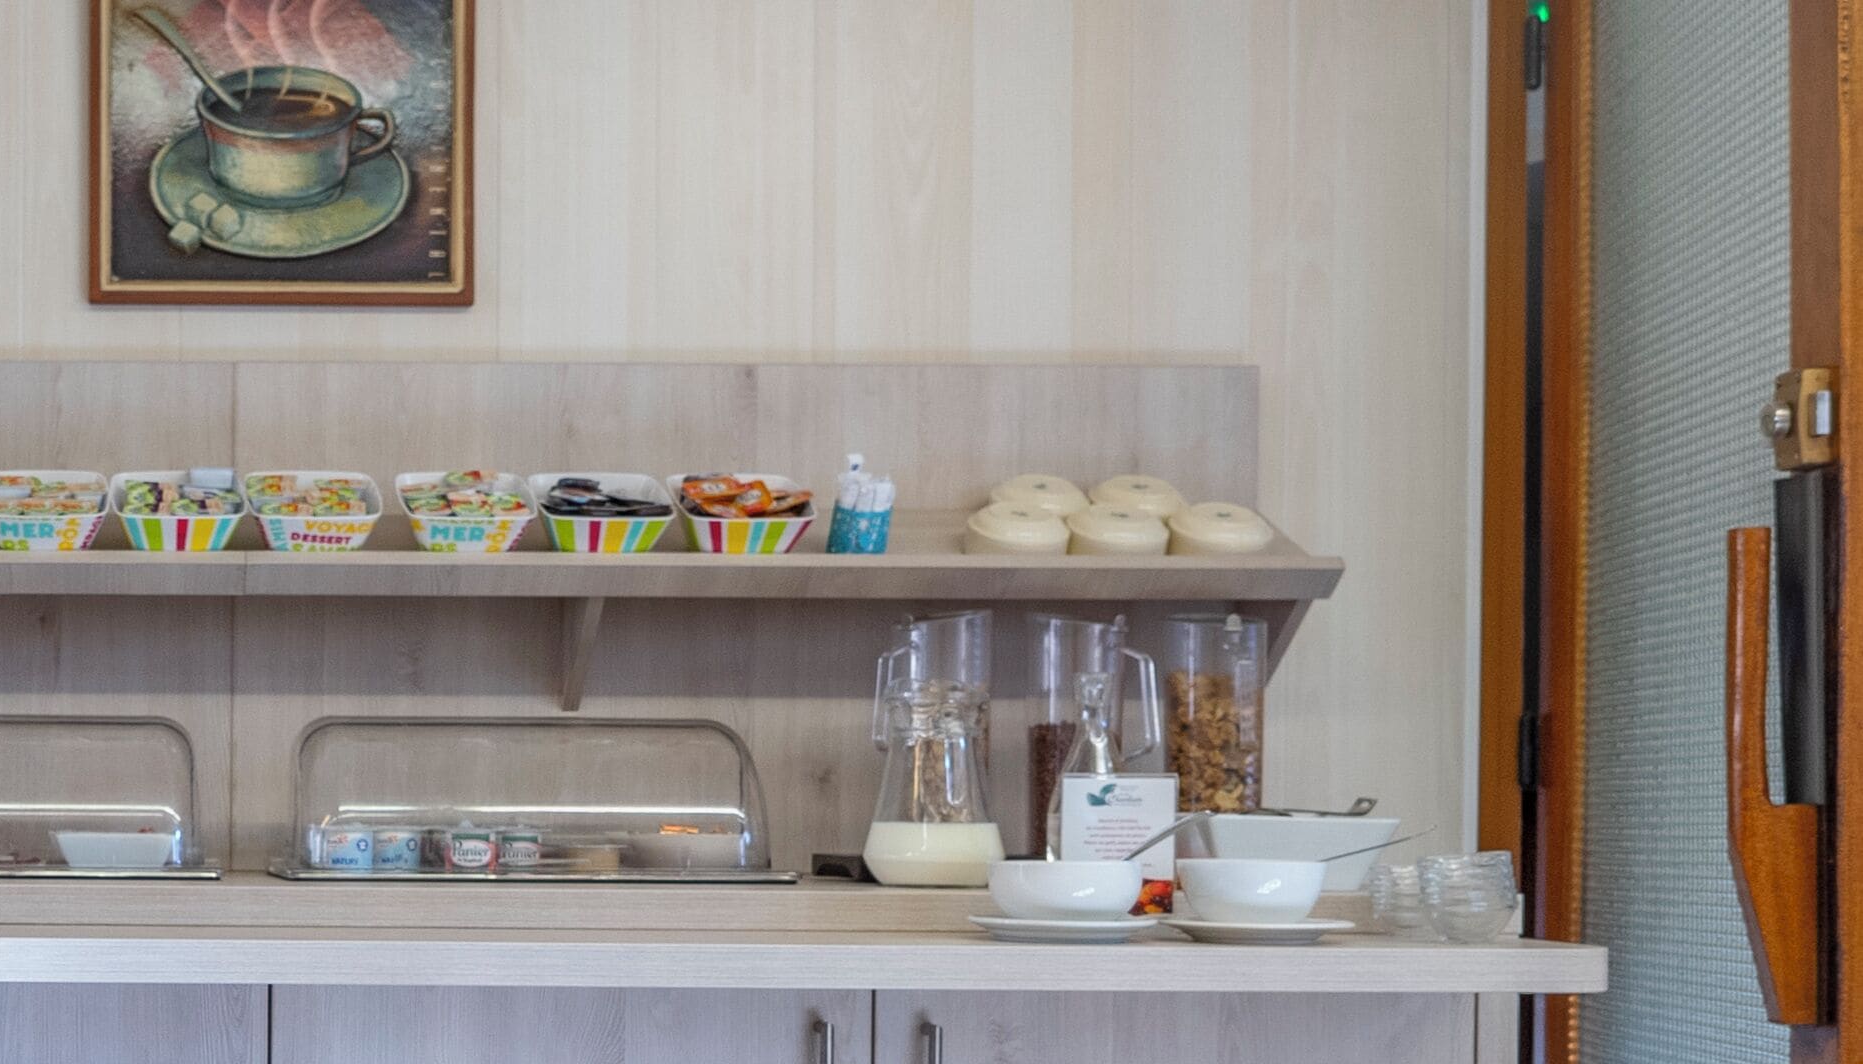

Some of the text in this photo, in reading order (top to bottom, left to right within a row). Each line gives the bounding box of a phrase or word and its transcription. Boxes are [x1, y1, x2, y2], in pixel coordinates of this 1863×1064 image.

[0, 521, 55, 538] MER
[430, 524, 486, 541] MER
[290, 532, 353, 545] DESSERT
[453, 838, 491, 858] Panier
